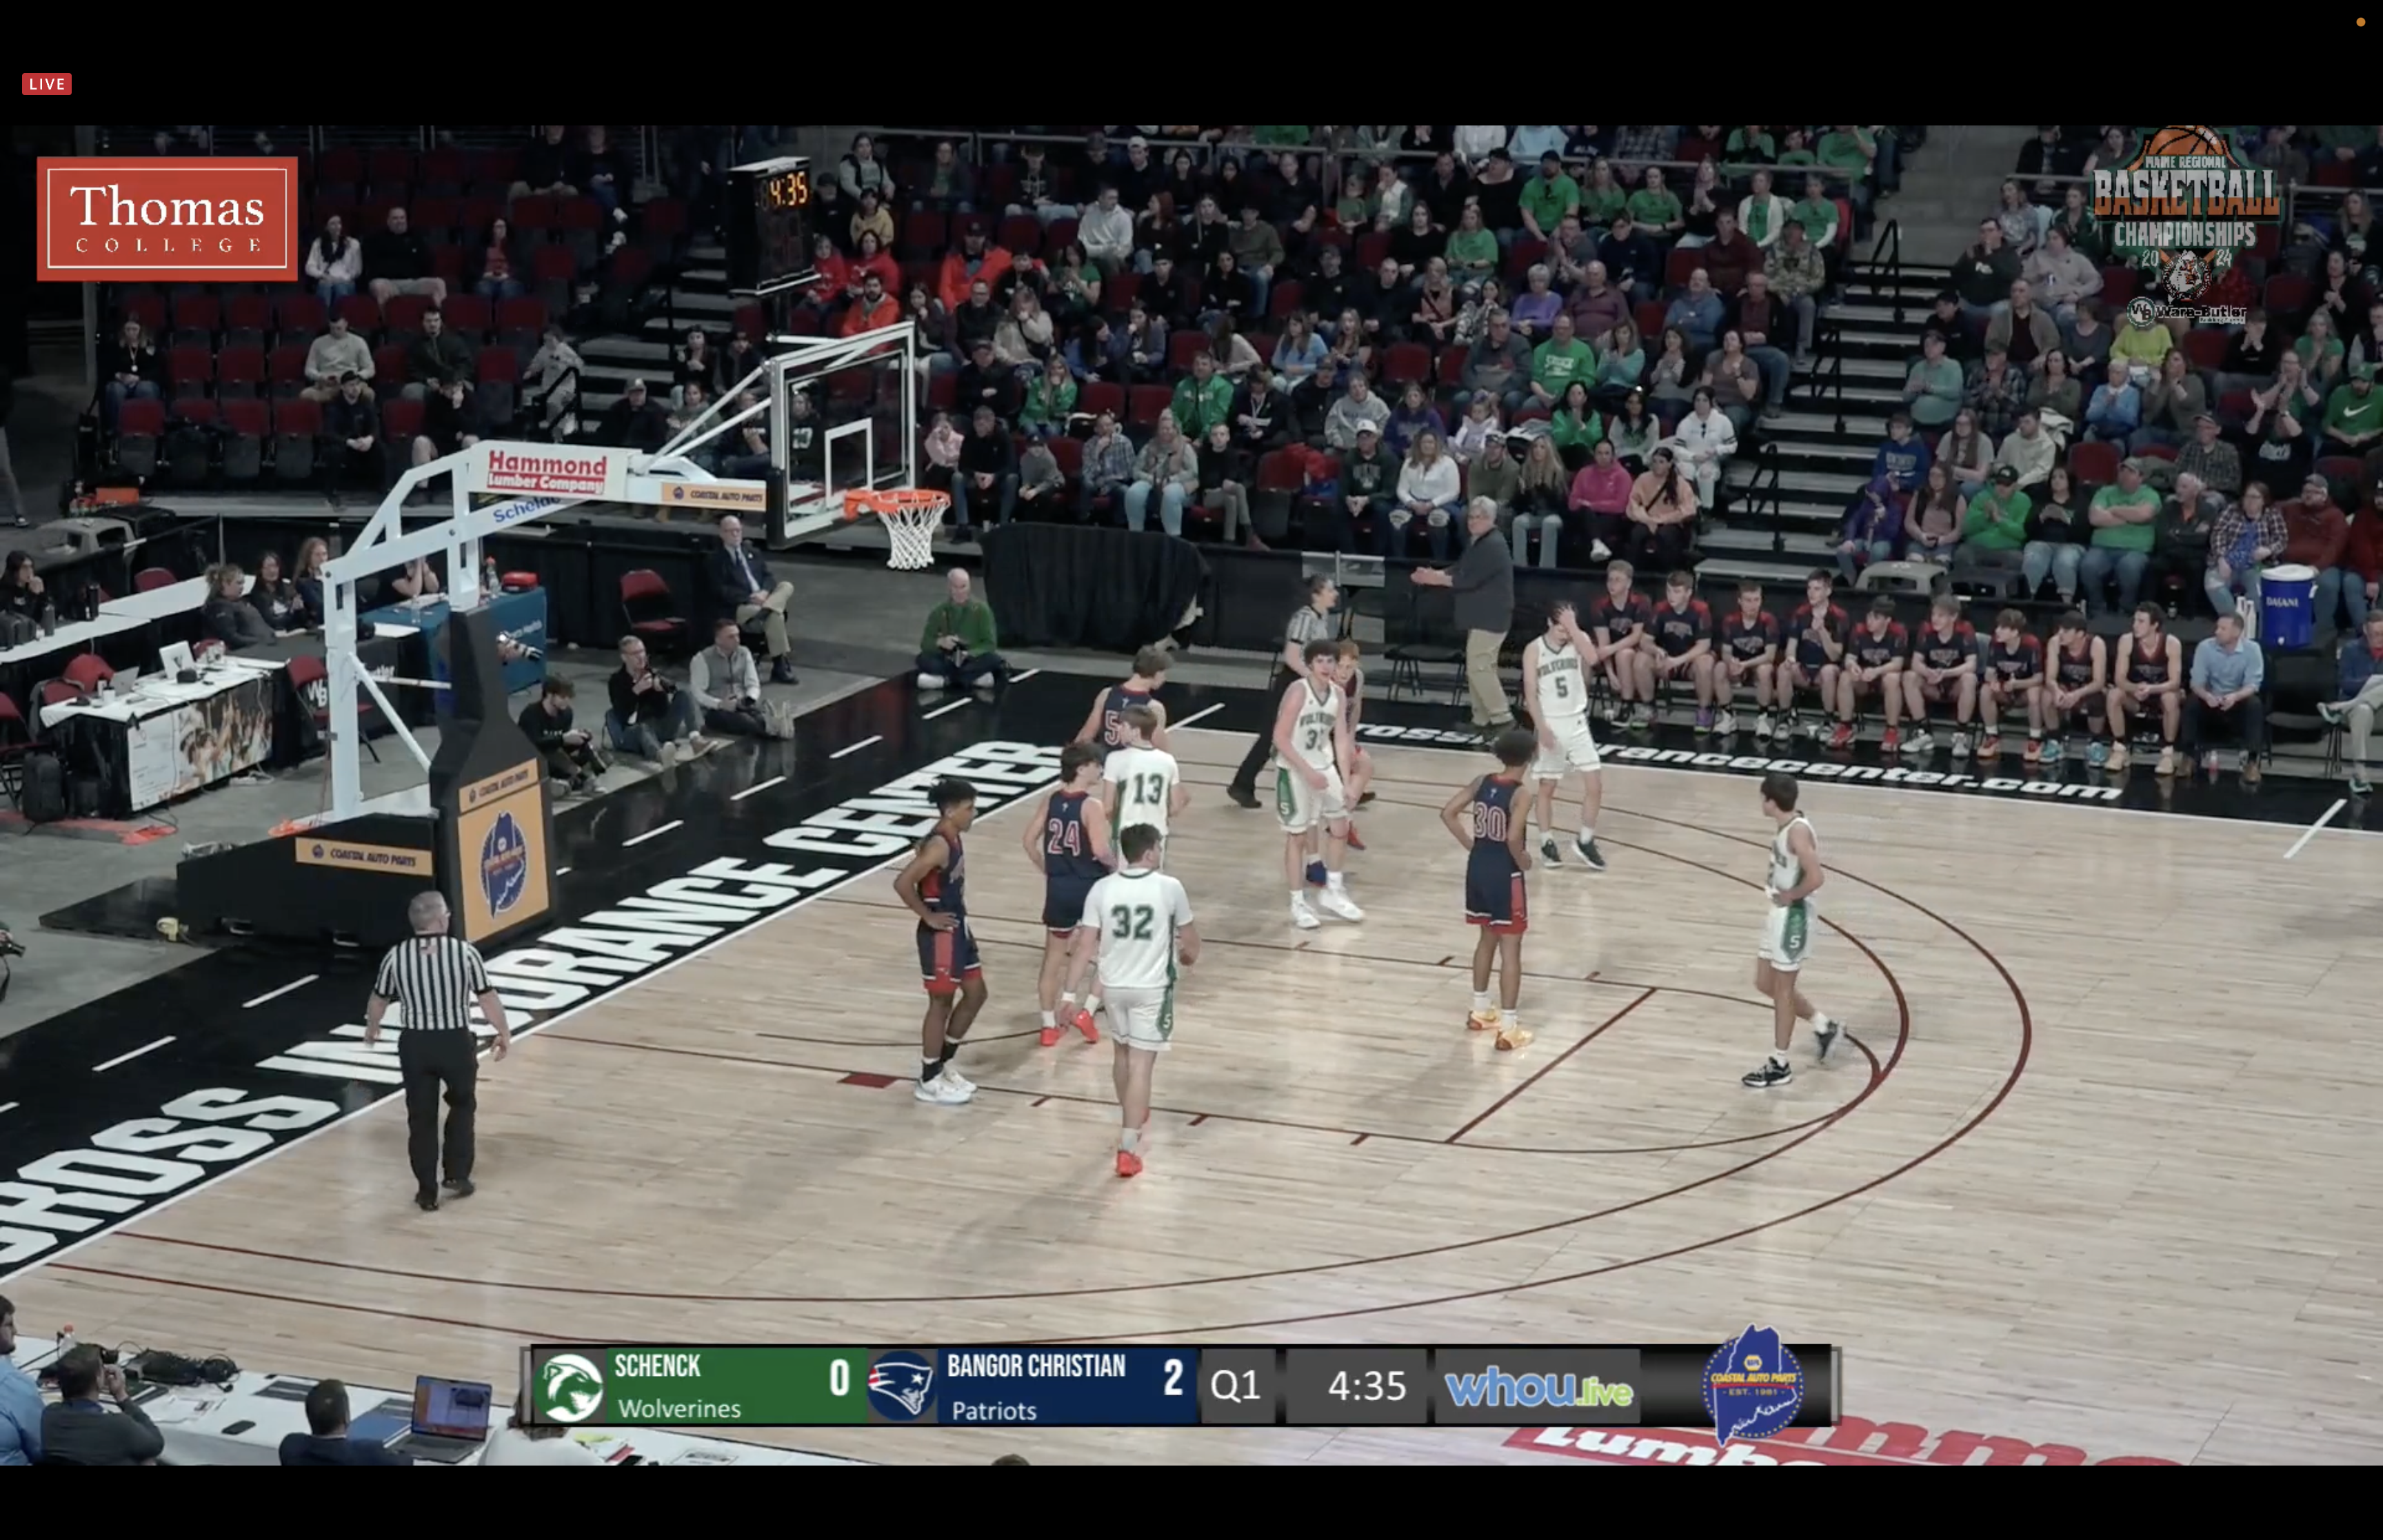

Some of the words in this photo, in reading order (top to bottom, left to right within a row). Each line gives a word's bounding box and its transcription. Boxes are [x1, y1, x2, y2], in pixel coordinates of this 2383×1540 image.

[770, 172, 807, 206] 4:35
[489, 450, 607, 475] Hammond
[487, 472, 538, 488] Lumber
[539, 476, 605, 494] Company
[1555, 676, 1568, 698] 5
[1134, 773, 1164, 804] 13
[1047, 818, 1081, 856] 24
[1474, 802, 1507, 842] 30
[367, 852, 389, 864] AUTO
[1112, 904, 1154, 940] 32
